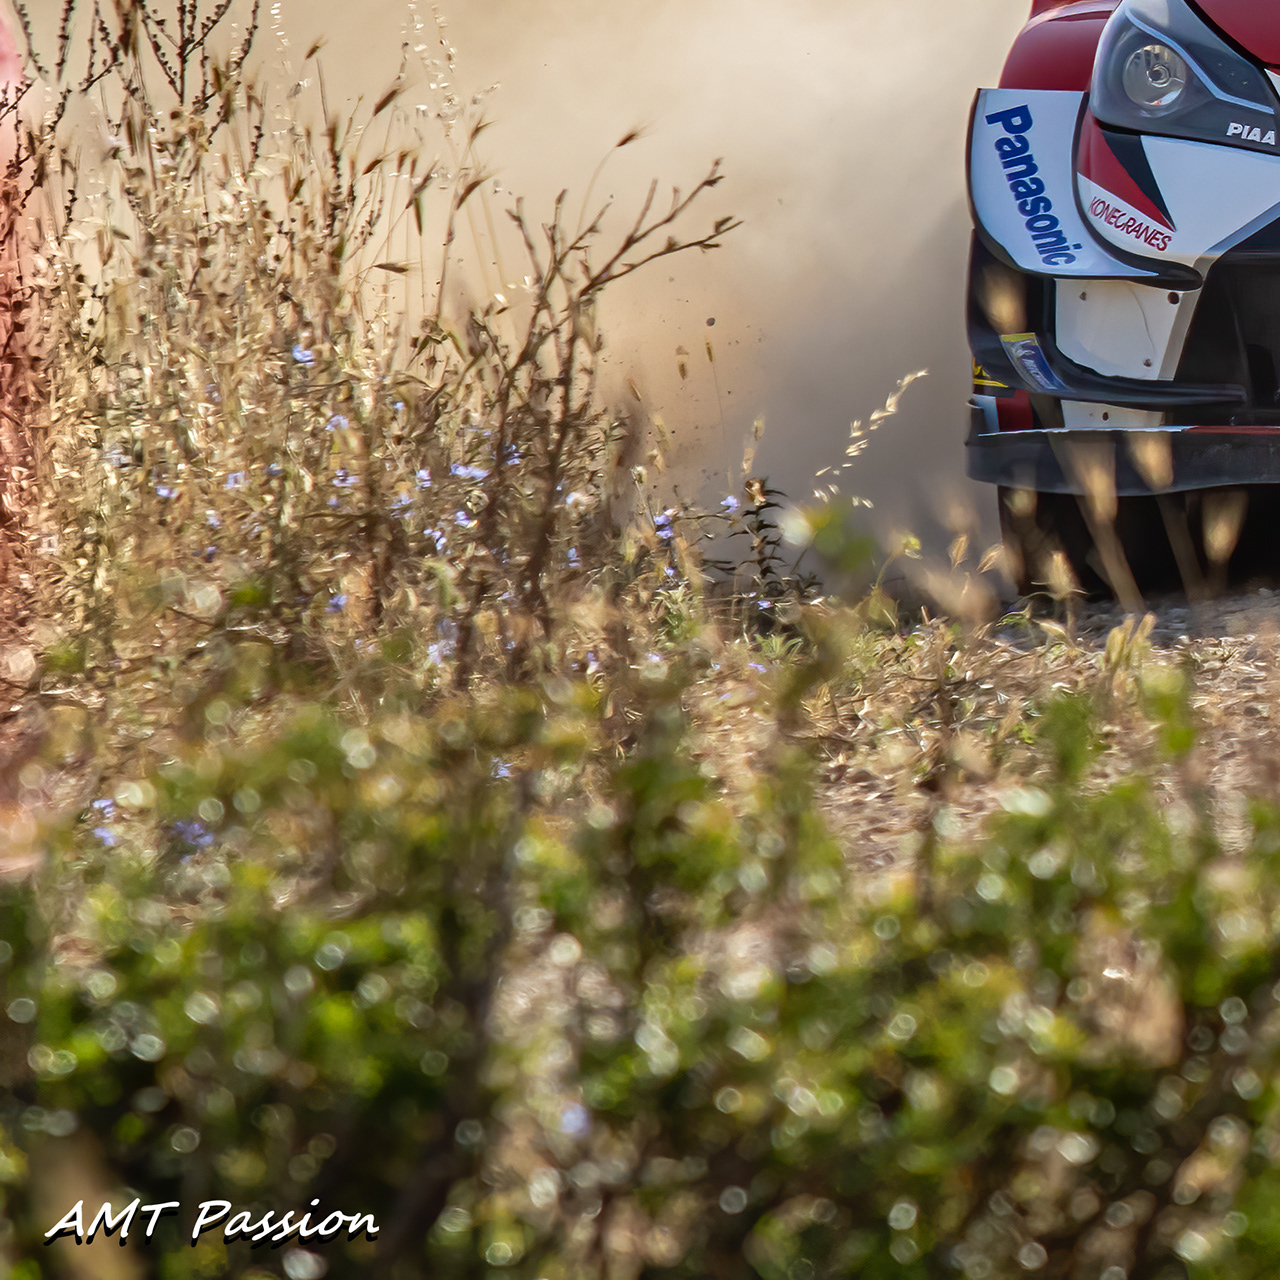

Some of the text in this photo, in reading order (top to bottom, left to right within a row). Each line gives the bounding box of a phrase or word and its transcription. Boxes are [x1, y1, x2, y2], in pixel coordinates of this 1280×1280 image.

[1226, 122, 1276, 146] PIAA
[985, 104, 1083, 266] Panasonic
[1088, 196, 1172, 252] KONECRANES
